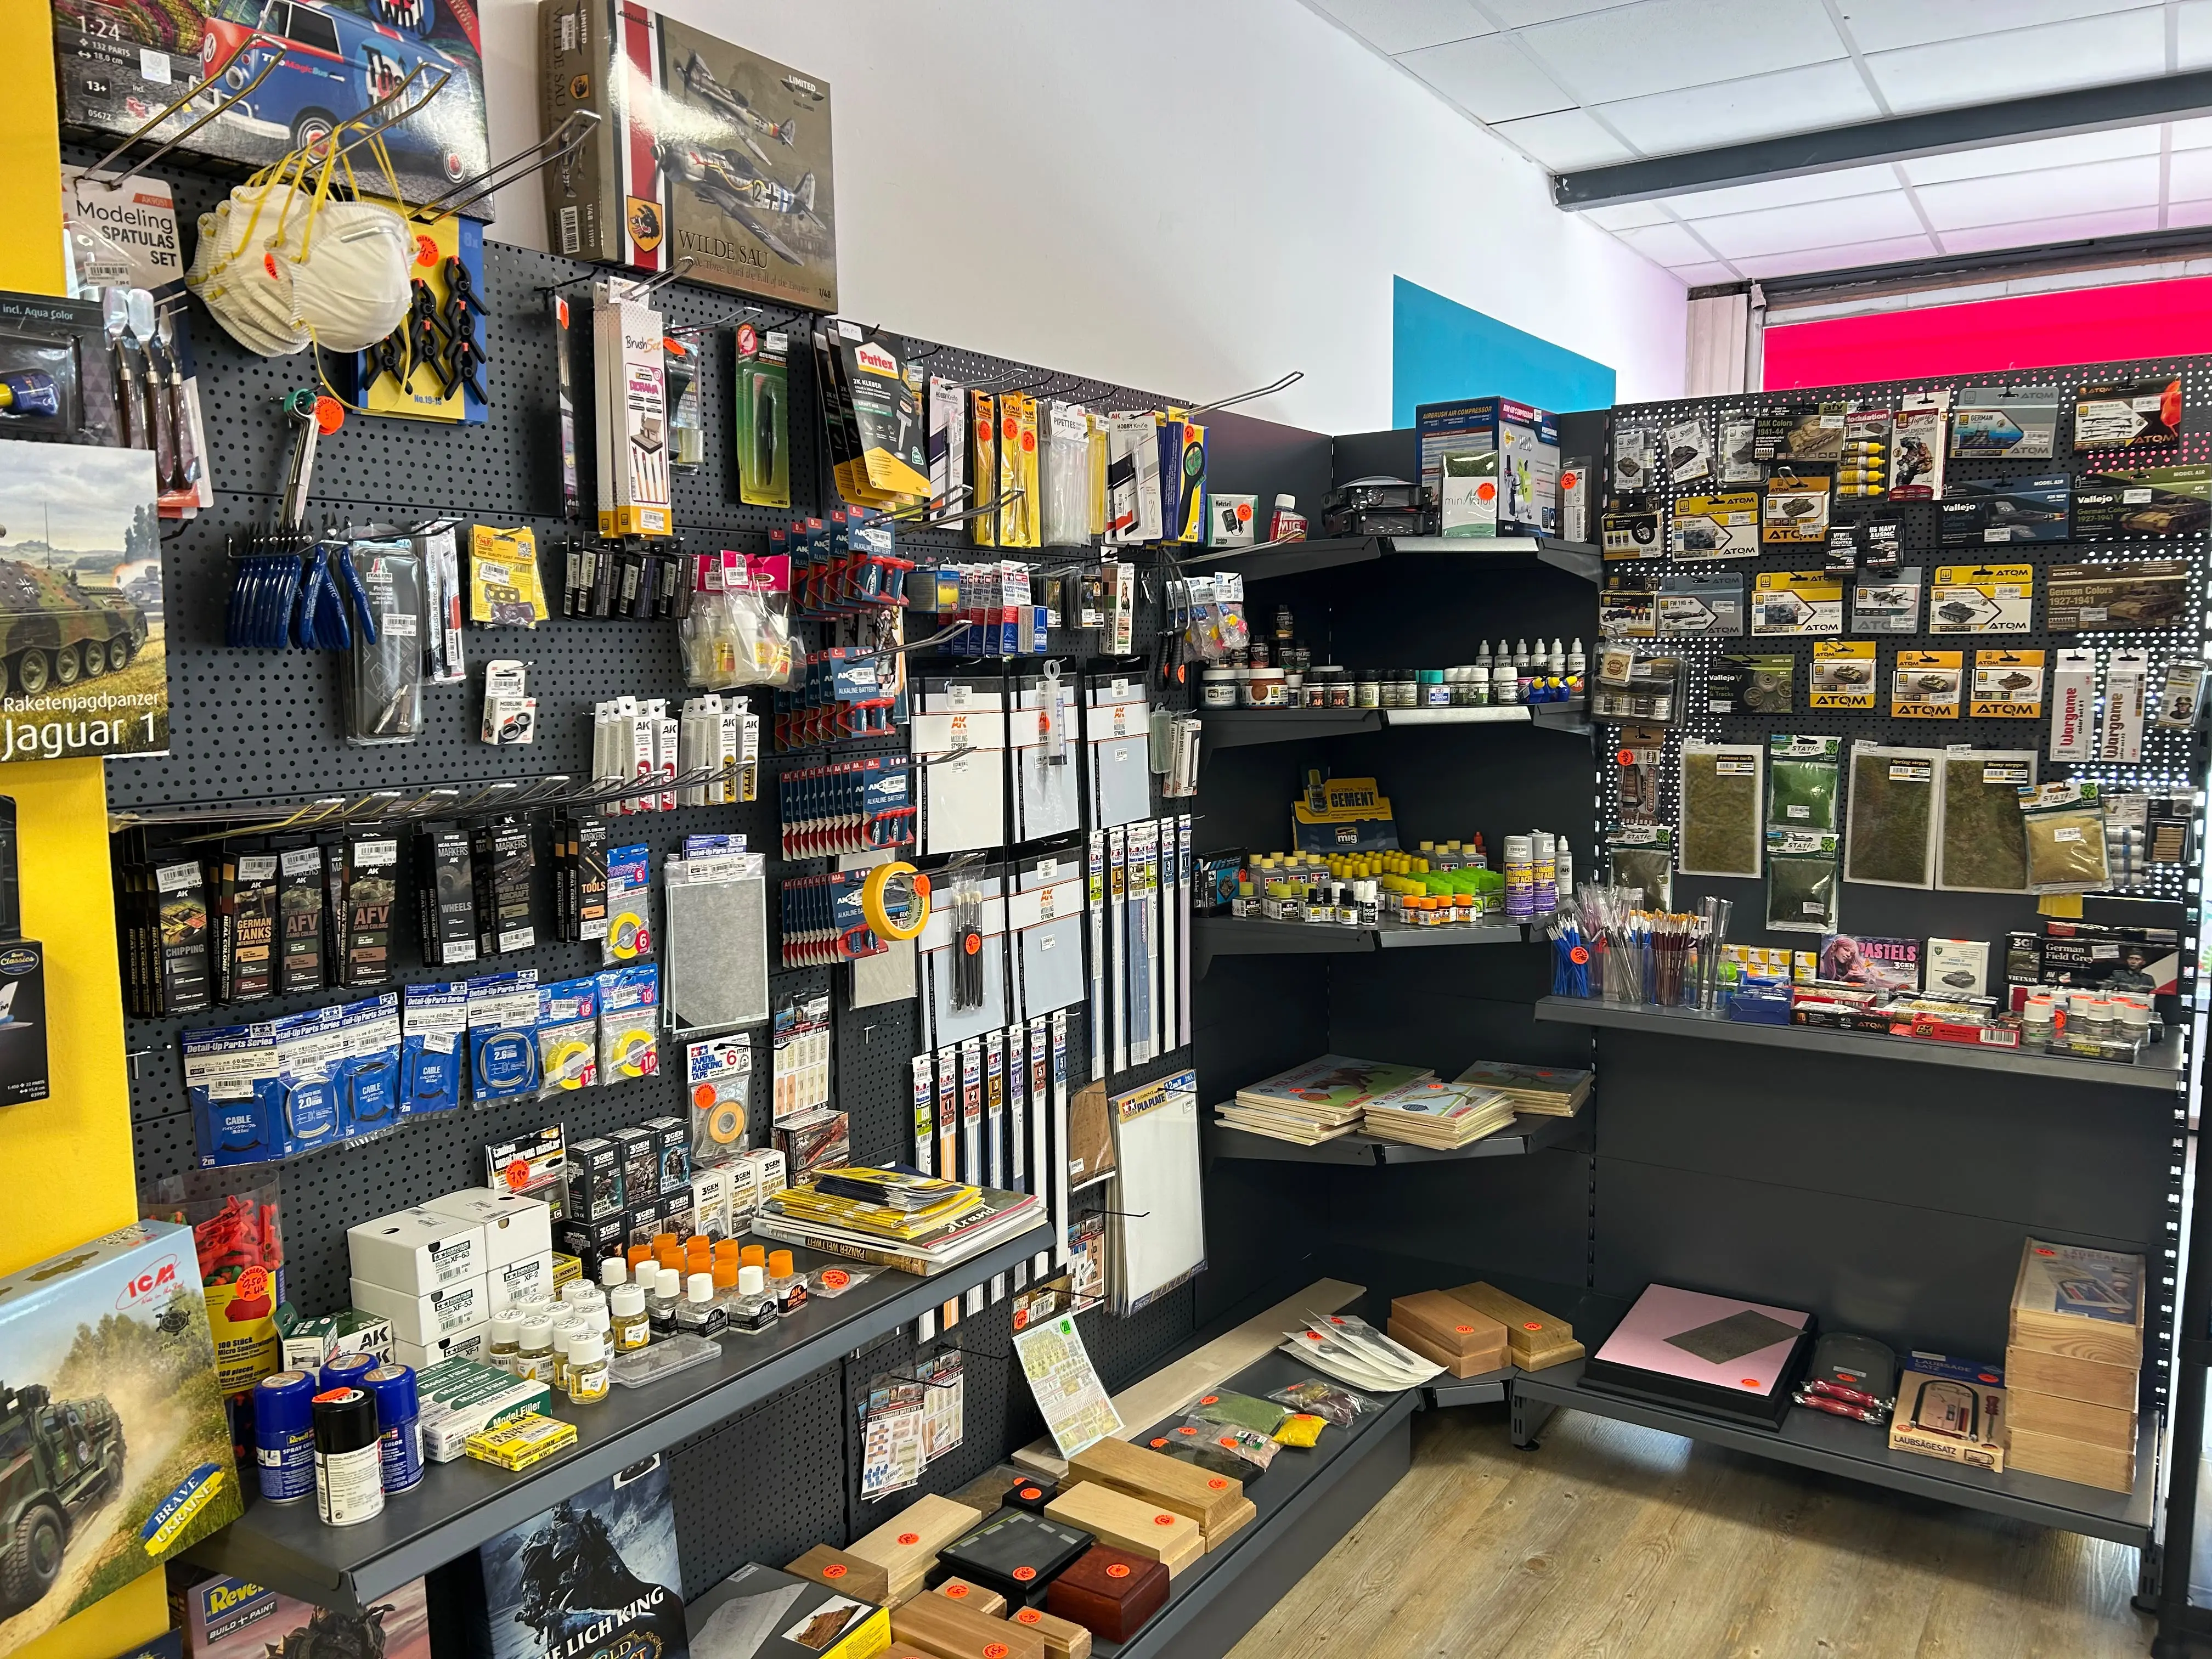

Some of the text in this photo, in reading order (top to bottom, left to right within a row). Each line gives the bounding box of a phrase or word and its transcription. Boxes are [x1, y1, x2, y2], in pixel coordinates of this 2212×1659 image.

[77, 15, 121, 42] 1:24
[92, 41, 131, 57] 132 PARTS
[112, 57, 123, 65] cm
[87, 81, 107, 92] 13+
[789, 75, 816, 92] LIMITED
[554, 74, 566, 108] SAU
[76, 200, 173, 234] Modeling
[102, 225, 174, 249] SPATULAS
[678, 229, 769, 269] WILDE SAU
[150, 251, 176, 267] SET
[819, 288, 831, 298] 1/48
[3, 304, 74, 320] incl. Aqua Color
[859, 351, 894, 370] Pattex
[862, 380, 882, 390] KLEBER
[1423, 410, 1447, 419] AIRBRUSH
[1457, 406, 1492, 416] COMPRESSOR
[1053, 417, 1075, 430] PIPETTES
[2078, 495, 2113, 504] Vallejo
[1943, 503, 1976, 512] Vallejo
[1278, 519, 1300, 531] MIG
[1876, 524, 1897, 533] NAVY
[1723, 548, 1755, 556] ATOM
[2050, 586, 2113, 596] German Colors
[2050, 596, 2095, 605] 1927-1941
[1989, 621, 2027, 630] ATOM
[3, 692, 159, 713] Raketenjagdpanzer
[1816, 695, 1867, 706] ATOM
[1114, 707, 1126, 718] AK
[1897, 704, 1951, 715] ATOM
[1977, 704, 2033, 715] ATOM
[723, 719, 735, 727] AK
[951, 716, 968, 729] AK
[2060, 688, 2076, 747] Wargame
[636, 721, 650, 731] AK
[663, 725, 676, 733] AK
[744, 720, 758, 729] AK
[2103, 692, 2124, 759] Wargame
[1, 713, 157, 760] Jaguar 1
[867, 796, 887, 805] ALKALINE
[1331, 791, 1374, 808] CEMENT
[580, 832, 606, 842] MARKERS
[1338, 834, 1357, 844] mig
[495, 839, 527, 851] MARKERS
[438, 847, 468, 857] MARKERS
[582, 881, 606, 894] TOOLS
[1041, 889, 1053, 901] AK
[441, 901, 472, 913] WHEELS
[355, 906, 388, 923] AFV
[237, 917, 272, 929] GERMAN
[287, 913, 318, 932] AFV
[237, 926, 272, 941] TANKS
[166, 944, 205, 957] CHIPPING
[1858, 942, 1916, 963] PASTELS
[2046, 943, 2085, 953] German
[1, 956, 35, 966] Classics
[2046, 951, 2094, 964] Field Grey
[276, 1020, 340, 1041] etail-Up Parts Series
[187, 1037, 273, 1053] Detail-Up Parts Series
[691, 1054, 716, 1065] TAMIYA
[726, 1049, 737, 1065] 6
[423, 1066, 441, 1075] CABLE
[691, 1060, 723, 1073] MASKING
[692, 1071, 708, 1080] TAPE
[362, 1083, 381, 1094] CABLE
[1149, 1093, 1166, 1108] PLATE
[225, 1115, 252, 1125] CABLE
[664, 1130, 684, 1143] 3GEN
[535, 1138, 561, 1156] master
[629, 1140, 650, 1155] 3GEN
[202, 1158, 215, 1166] 2m
[593, 1150, 614, 1167] 3GEN
[765, 1159, 780, 1171] 3GEN
[735, 1170, 751, 1183] 3GEN
[806, 1236, 865, 1259] PANZER WELTWEIT
[450, 1251, 470, 1262] XF-63
[128, 1263, 176, 1299] ICM
[239, 1266, 268, 1283] SONDERPREIS
[524, 1272, 539, 1282] XF-2
[453, 1300, 472, 1312] XF-53
[159, 1331, 196, 1352] PRACTIKA
[217, 1336, 253, 1350] 100 Stück
[359, 1325, 389, 1351] AK
[218, 1347, 236, 1356] Micro
[466, 1346, 479, 1356] XF-1
[420, 1375, 449, 1389] Model
[439, 1372, 490, 1395] Model Filler
[458, 1379, 509, 1403] Model Filler
[477, 1383, 527, 1407] Model Filler
[520, 1400, 541, 1415] Filler
[489, 1418, 541, 1441] MASKING
[289, 1431, 309, 1444] Revell
[283, 1446, 302, 1455] SPRAY
[1893, 1435, 1957, 1455] LAUBSÄGESATZ
[154, 1476, 199, 1525] BRAVE
[154, 1481, 215, 1544] UKRAINE
[209, 1583, 264, 1615] Reve
[209, 1601, 275, 1639] BUILD PAINT
[566, 1585, 664, 1657] LICH KING
